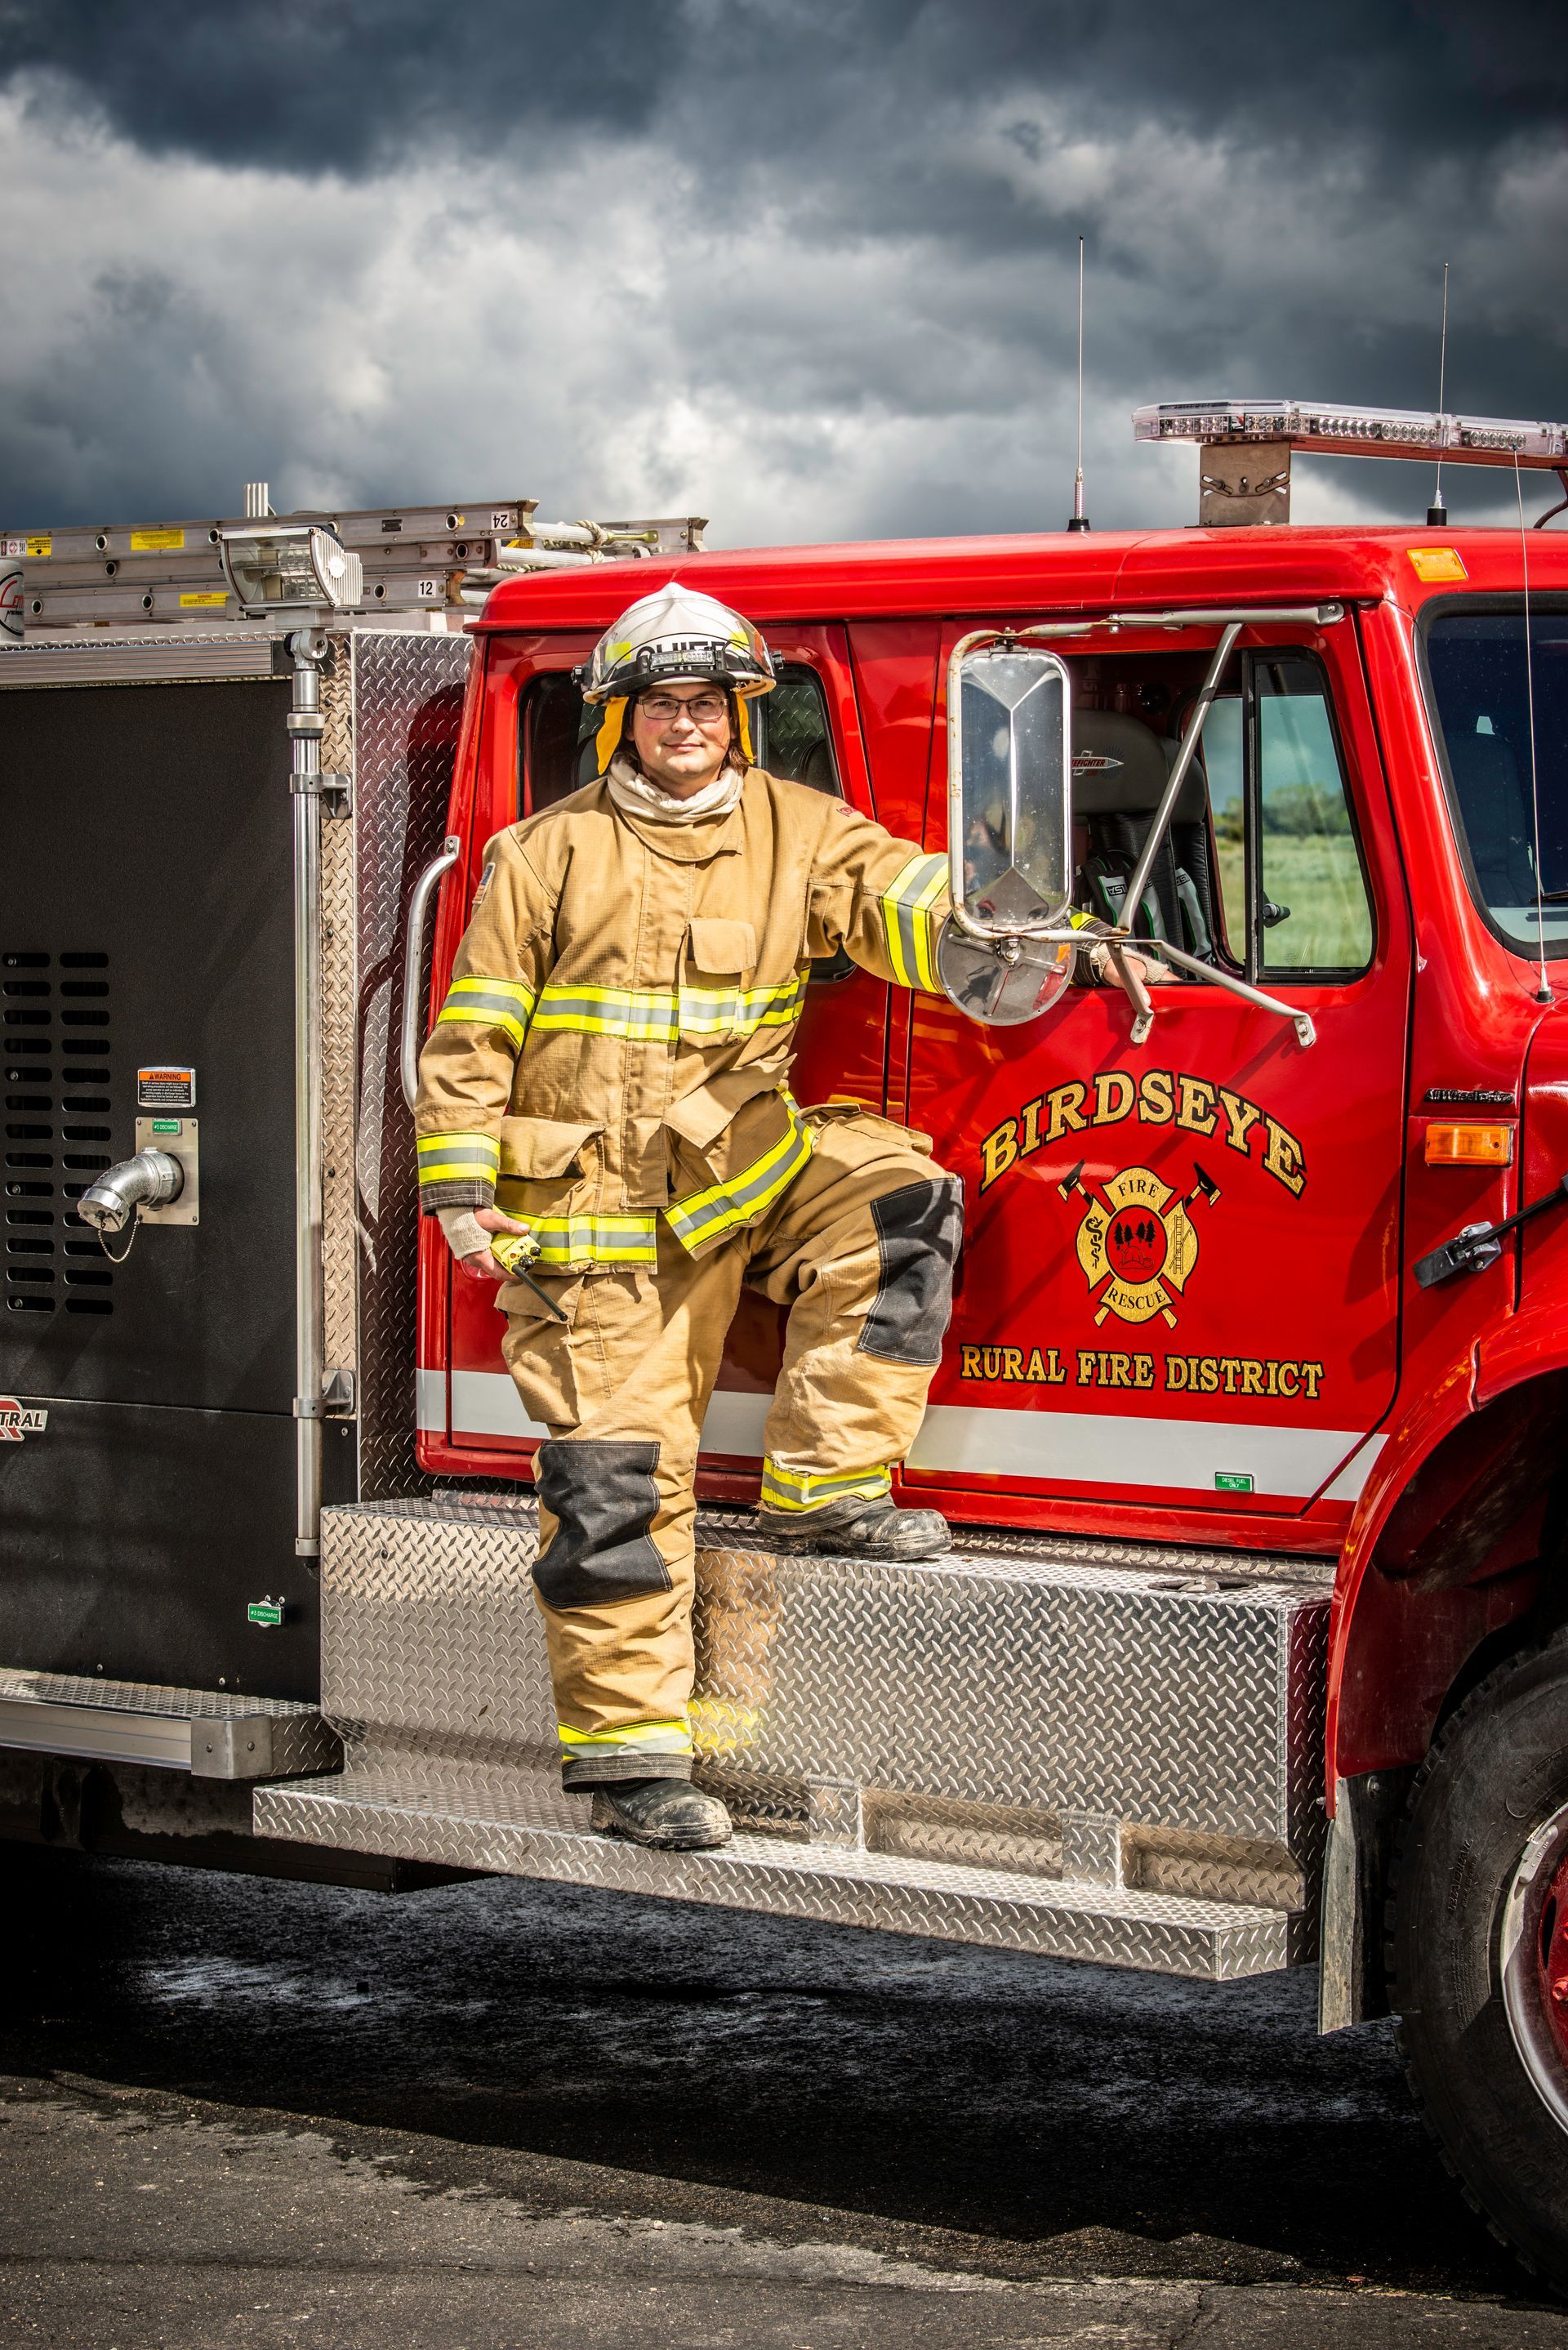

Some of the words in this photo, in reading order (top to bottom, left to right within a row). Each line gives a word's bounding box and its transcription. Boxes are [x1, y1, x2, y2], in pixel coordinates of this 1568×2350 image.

[493, 515, 507, 528] 24
[420, 582, 432, 595] 12
[1442, 1090, 1477, 1100] Wheel
[980, 1069, 1307, 1200] BIRDSEYE
[1116, 1179, 1160, 1198] FIRE
[1108, 1287, 1166, 1309] RESCUE
[960, 1344, 1067, 1385] RURAL
[1077, 1349, 1156, 1389] FIRE
[1166, 1356, 1325, 1400] DISTRICT
[0, 1411, 43, 1428] TRAL
[257, 1611, 278, 1619] DISCHARGE
[1447, 1839, 1474, 1911] RADIAL
